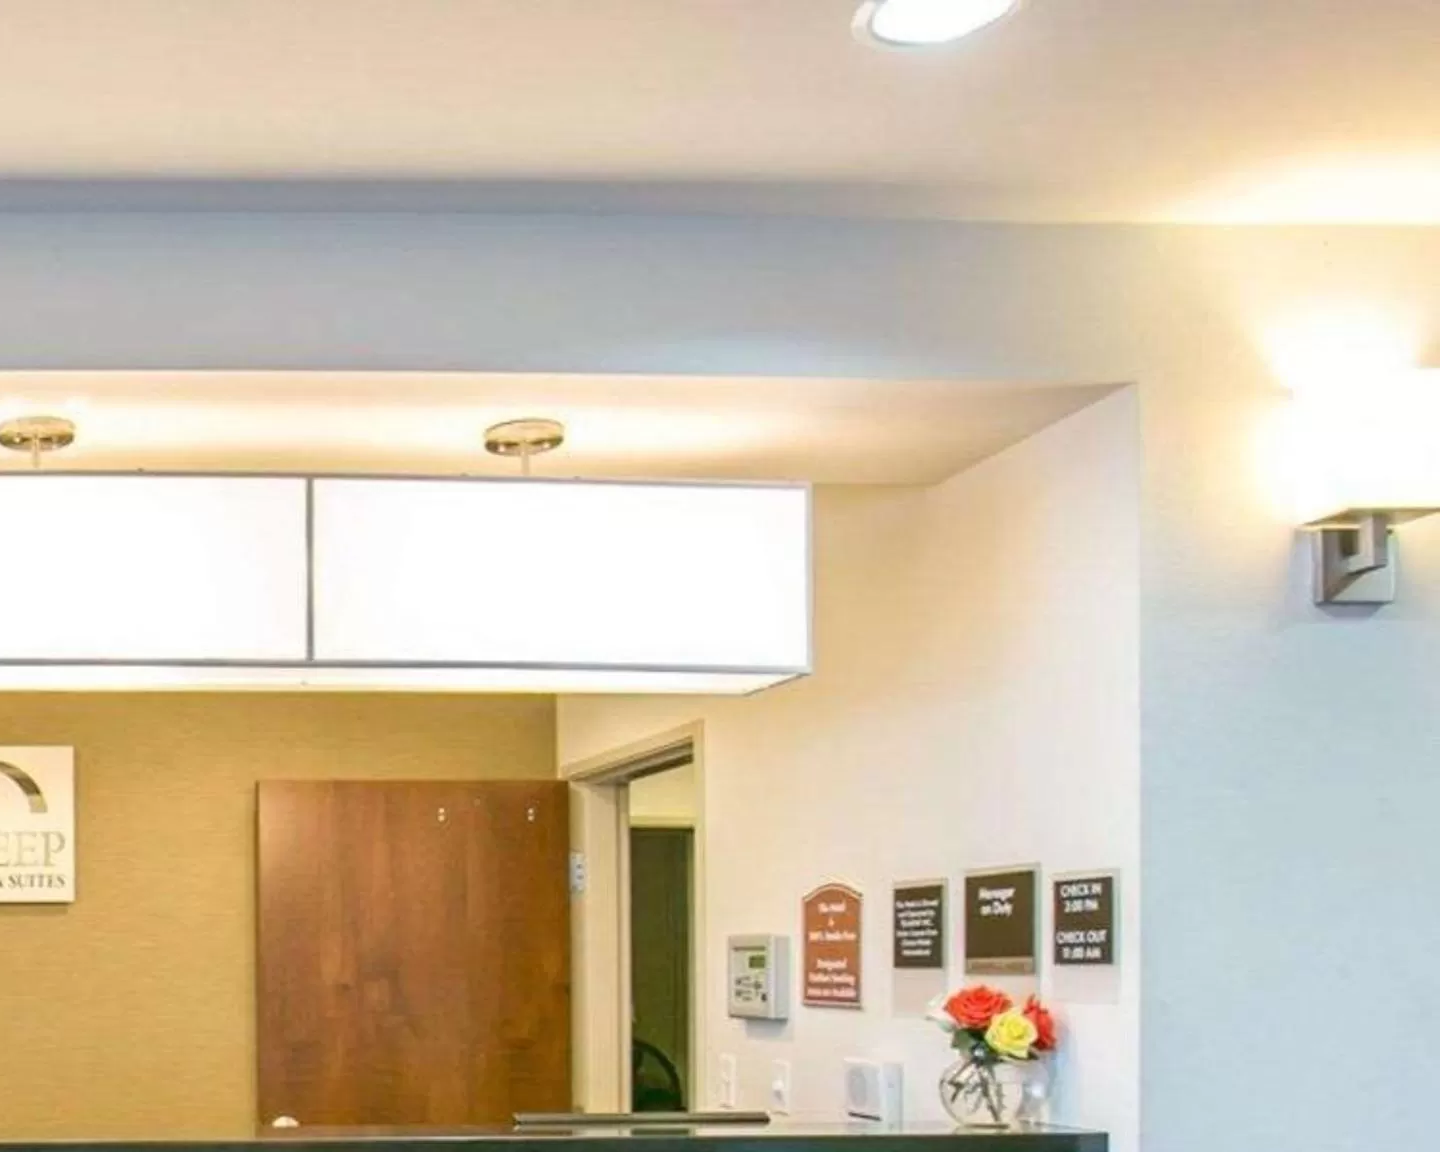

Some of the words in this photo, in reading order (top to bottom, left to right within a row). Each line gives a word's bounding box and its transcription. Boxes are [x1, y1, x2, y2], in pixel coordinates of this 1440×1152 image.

[8, 873, 67, 890] SUITES
[1060, 884, 1090, 898] CHECK
[1092, 882, 1102, 896] IN
[1055, 931, 1085, 945] CHECK
[1086, 929, 1107, 944] OUT
